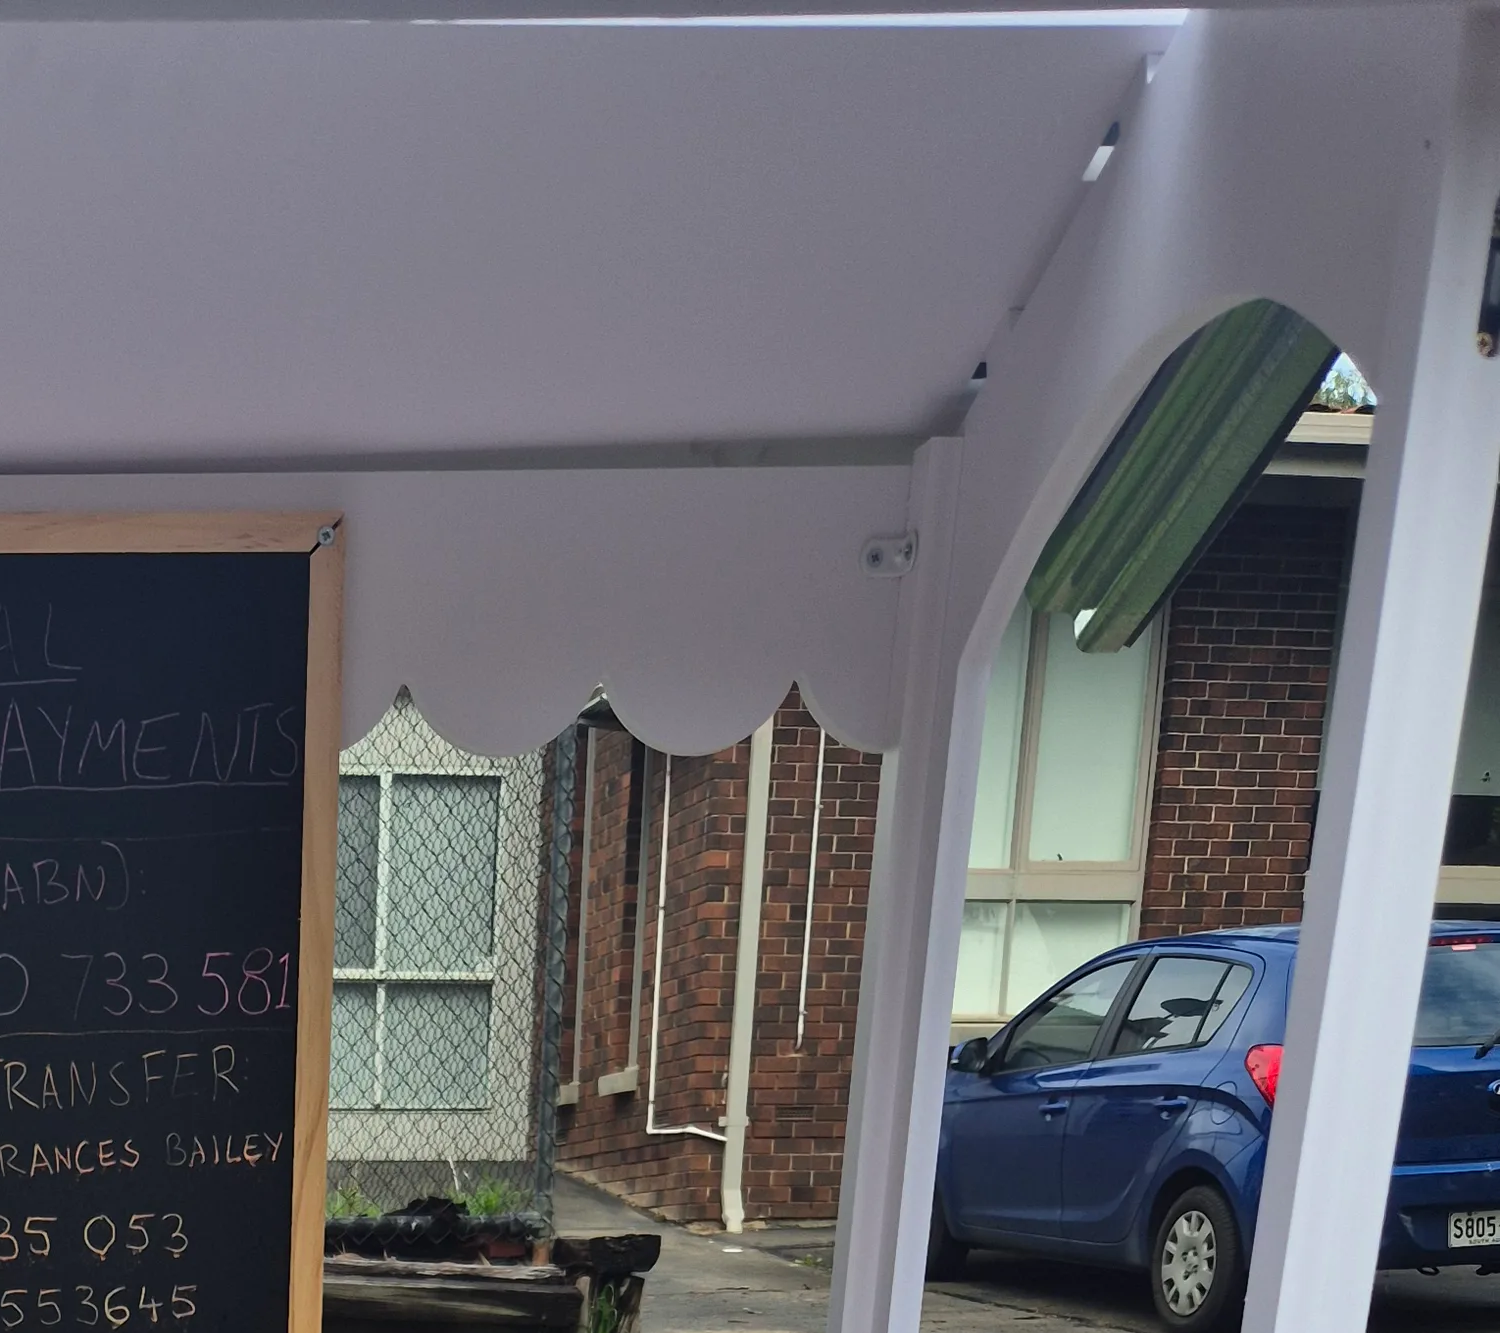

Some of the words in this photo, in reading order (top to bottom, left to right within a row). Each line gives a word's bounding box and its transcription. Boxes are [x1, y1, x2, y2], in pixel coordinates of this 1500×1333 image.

[61, 952, 178, 1020] 733
[198, 947, 292, 1017] 581
[165, 1131, 284, 1168] BAILEY
[83, 1213, 190, 1260] 053
[0, 1284, 199, 1329] 553645
